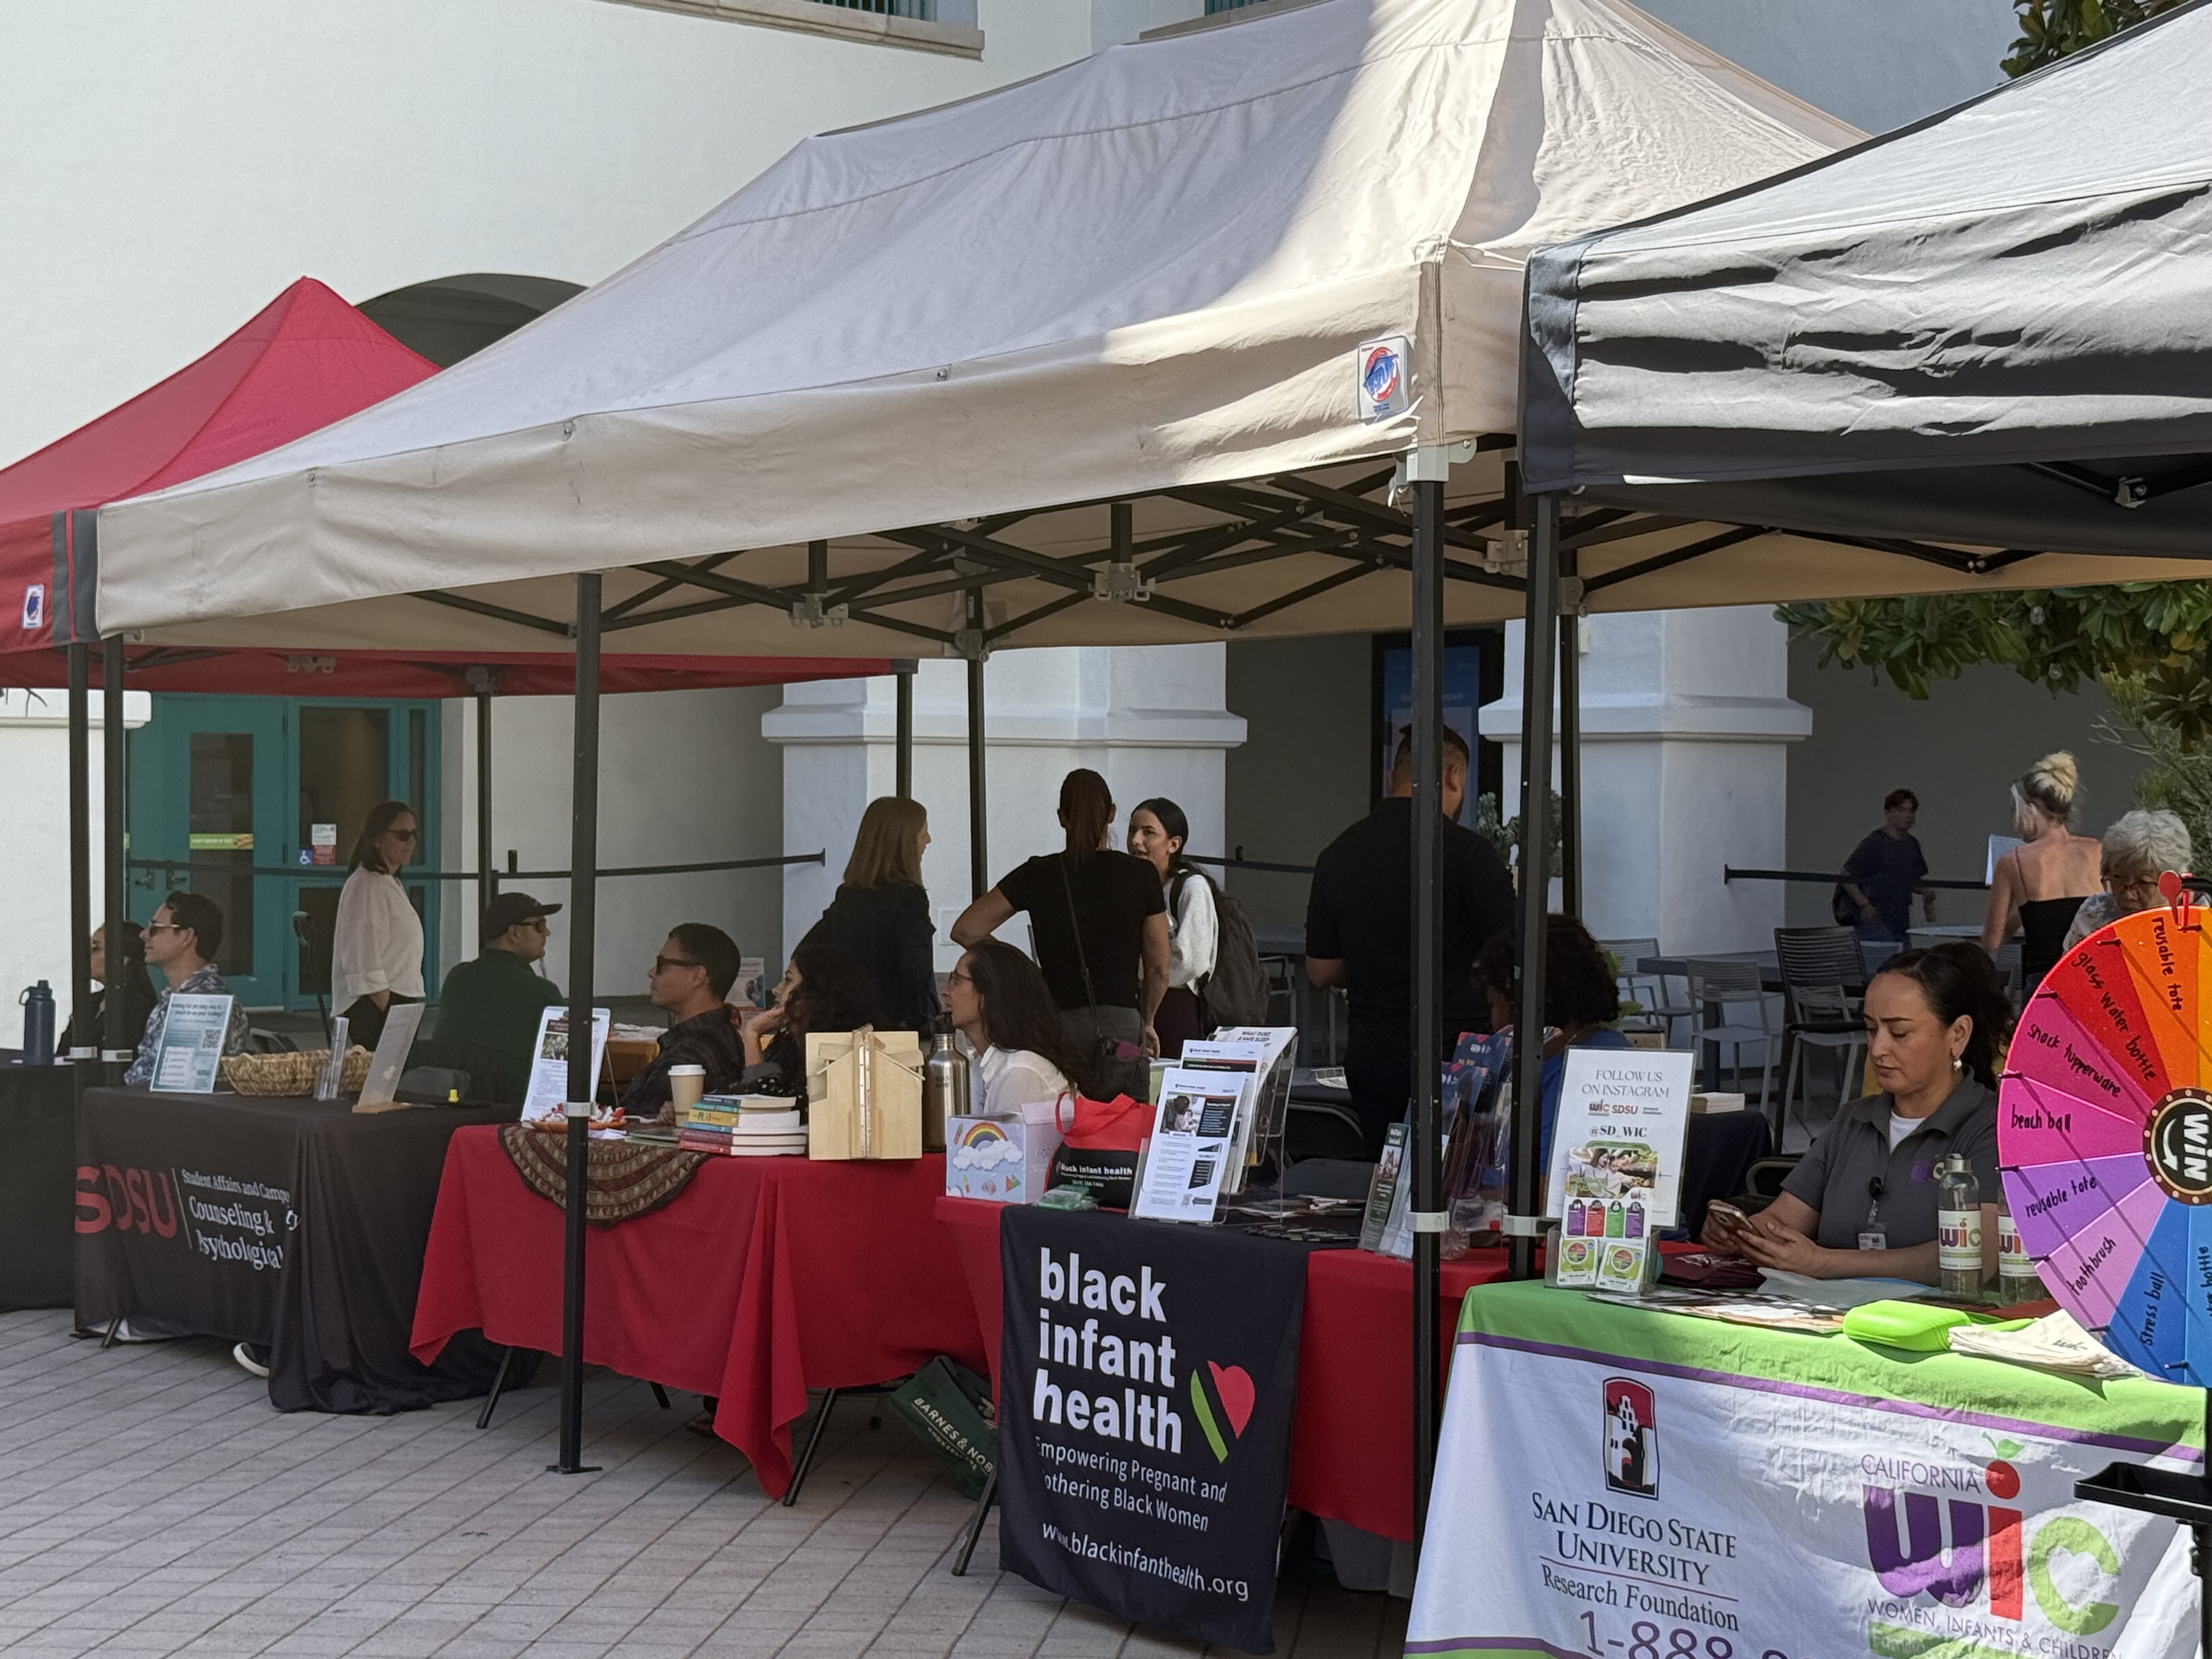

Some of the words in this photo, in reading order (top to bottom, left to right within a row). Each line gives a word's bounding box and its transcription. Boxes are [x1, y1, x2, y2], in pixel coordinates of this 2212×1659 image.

[2152, 917, 2176, 976] reusable
[2168, 983, 2183, 1012] tote
[2071, 952, 2104, 989] glass
[2125, 1035, 2157, 1081] bottle
[1596, 1069, 1646, 1081] FOLLOW
[1647, 1071, 1663, 1082] US
[2027, 1024, 2061, 1049] snack
[2063, 1043, 2121, 1098] tupperware
[1582, 1084, 1601, 1095] ON
[1602, 1084, 1669, 1098] INSTAGRAM
[1612, 1104, 1639, 1115] SDSU
[1589, 1125, 1647, 1138] @SD_WIC
[2011, 1104, 2042, 1129] beach
[2047, 1111, 2072, 1133] ball
[182, 1169, 212, 1188] Student
[212, 1175, 241, 1193] Affairs
[241, 1181, 260, 1196] and
[1104, 1166, 1133, 1176] health
[2025, 1188, 2068, 1218] reusable
[2070, 1176, 2097, 1196] tote
[75, 1164, 177, 1239] SDSU
[189, 1195, 266, 1236] Counseling
[263, 1209, 275, 1235] &
[1940, 1221, 1982, 1247] wic
[1999, 1228, 2022, 1254] wi
[1041, 1246, 1167, 1323] black
[2067, 1236, 2117, 1296] toothbrush
[2144, 1271, 2165, 1301] ball
[1039, 1307, 1176, 1389] infant
[913, 1397, 960, 1440] BARNES
[957, 1437, 968, 1451] &
[967, 1446, 994, 1473] NOB
[1033, 1368, 1182, 1454] health
[1131, 1459, 1197, 1495] Pregnant
[1200, 1481, 1228, 1503] and
[1861, 1454, 1982, 1494] CALIFORNIA
[1043, 1471, 1110, 1509] othering
[1114, 1487, 1154, 1516] Black
[1156, 1498, 1209, 1532] Women
[1532, 1492, 1579, 1527] SAN
[1585, 1501, 1663, 1542] DIEGO
[1668, 1519, 1737, 1559] STATE
[1556, 1530, 1711, 1587] UNIVERSITY
[1862, 1459, 2121, 1636] wic
[1541, 1564, 1618, 1607] Research
[1624, 1584, 1740, 1632] Foundation
[1867, 1598, 1940, 1632] WOMEN,
[1946, 1615, 2015, 1646] INFANTS
[2021, 1633, 2032, 1650] &
